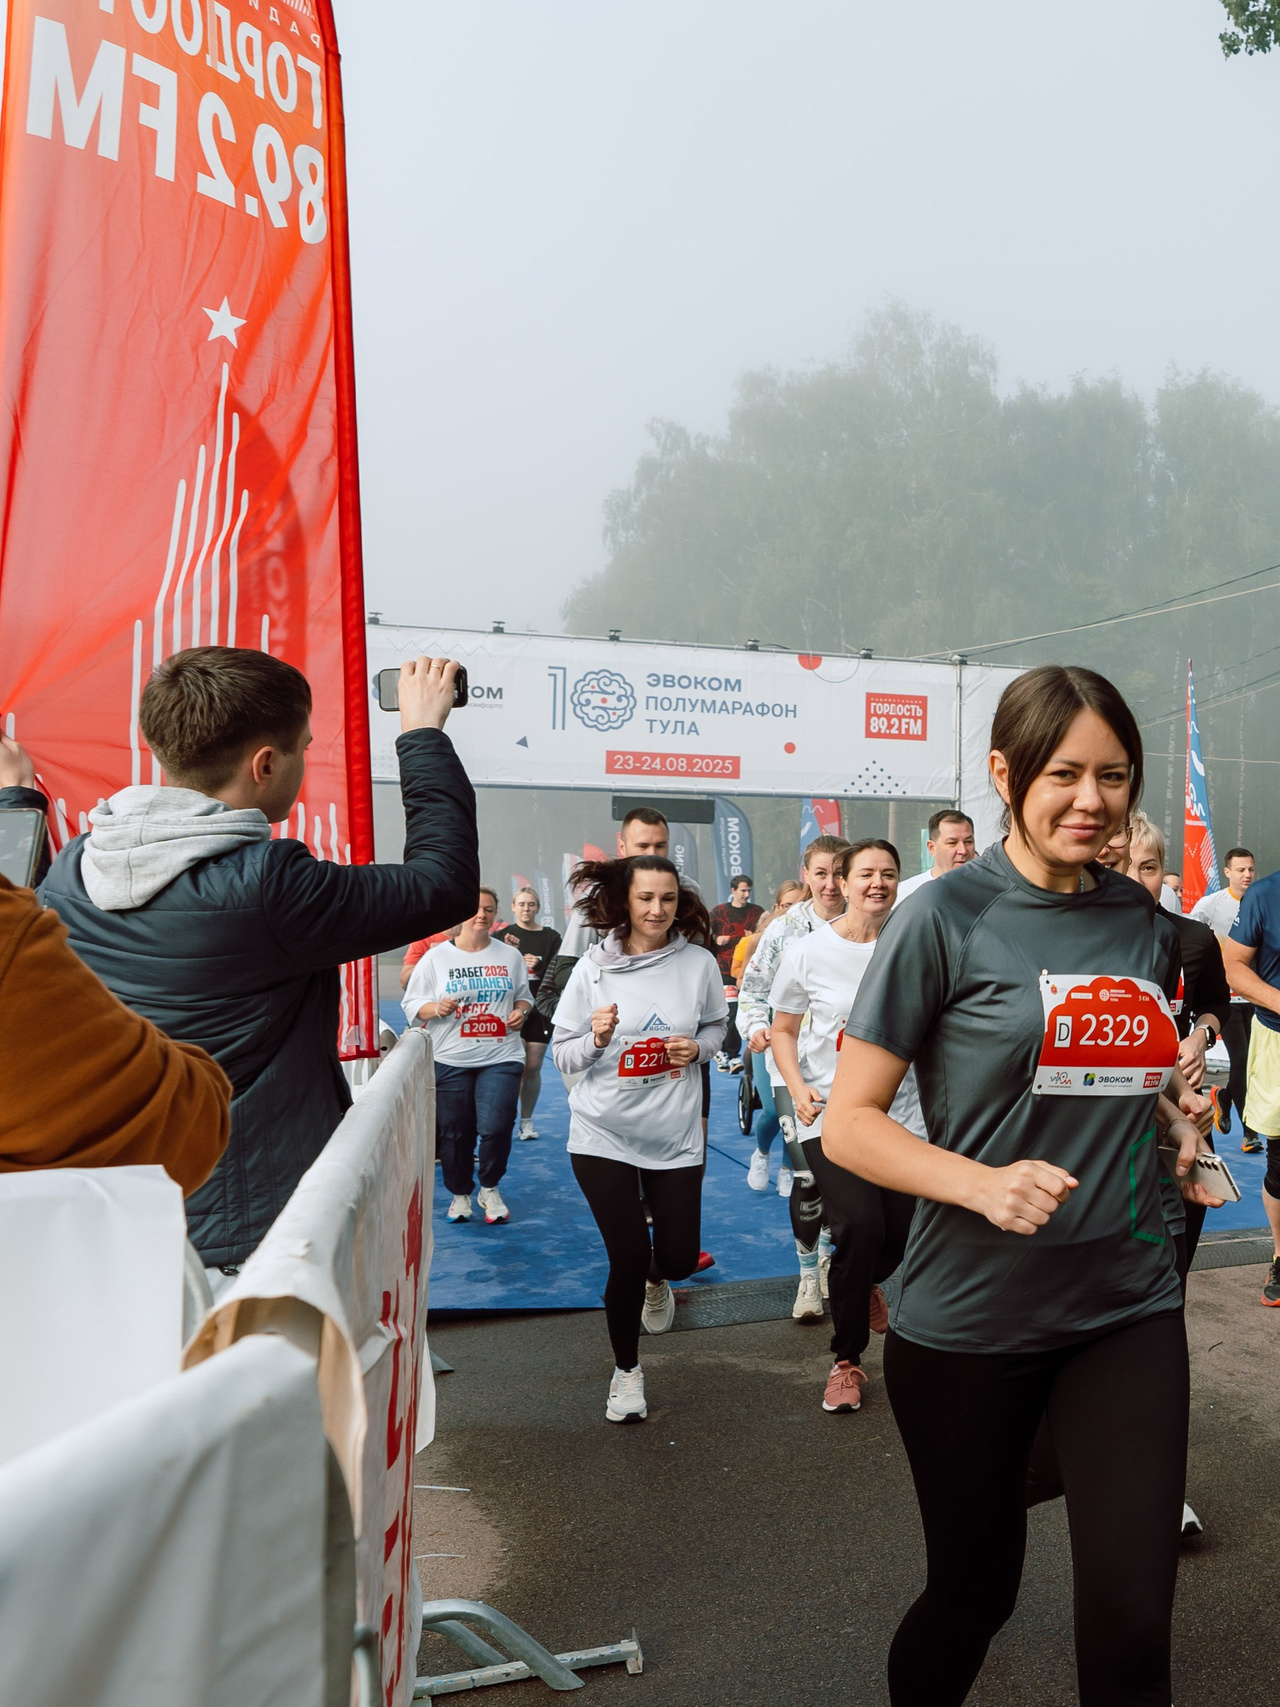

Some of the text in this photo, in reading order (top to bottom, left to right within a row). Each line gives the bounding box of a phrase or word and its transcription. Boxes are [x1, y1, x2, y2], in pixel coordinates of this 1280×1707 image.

[646, 673, 742, 692] ЭВОКОМ
[645, 696, 798, 718] ПОЛУМАРАФОН
[870, 702, 923, 717] ГОРДОСТЬ
[645, 718, 700, 736] ТУЛА
[869, 716, 922, 735] 89.2 FM
[613, 754, 733, 774] 23-24.08.2025
[445, 977, 513, 994] 45% ПЛАНЕТЫ
[477, 989, 507, 1003] БЕГУТ
[472, 1022, 498, 1032] 2010
[1057, 1013, 1149, 1046] D 2329
[626, 1058, 634, 1066] D
[1098, 1076, 1134, 1084] ЭВОКОМ
